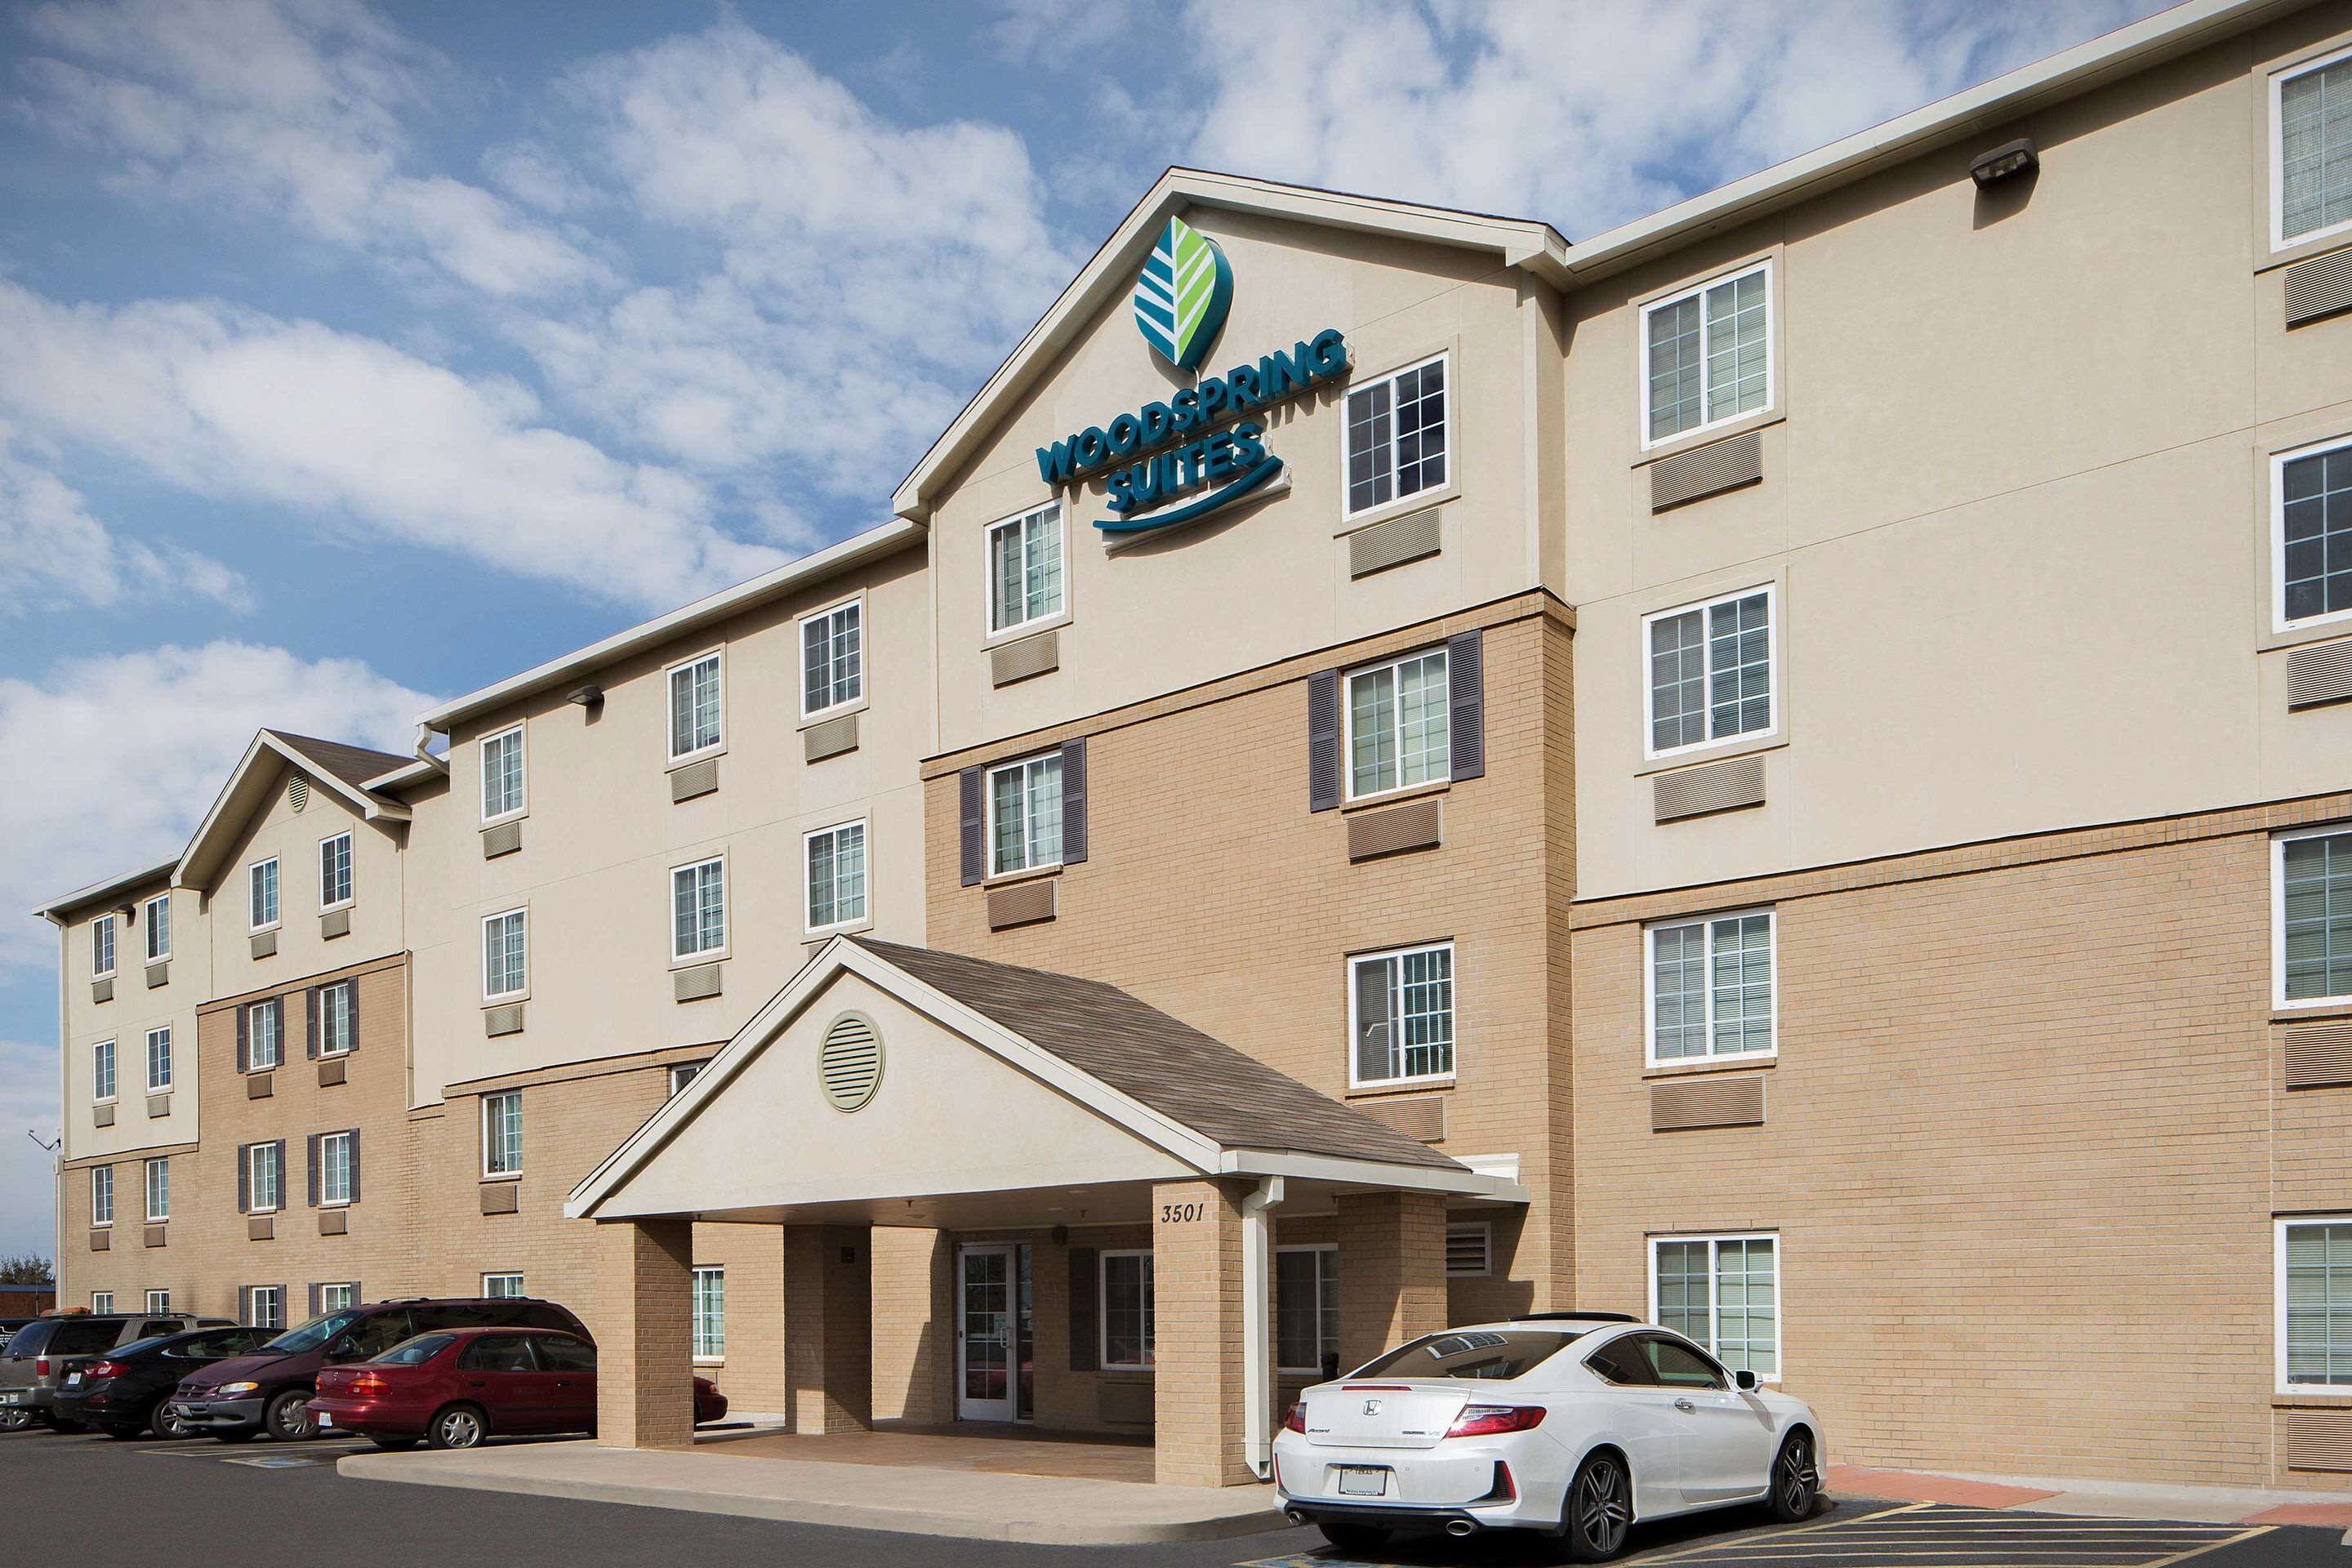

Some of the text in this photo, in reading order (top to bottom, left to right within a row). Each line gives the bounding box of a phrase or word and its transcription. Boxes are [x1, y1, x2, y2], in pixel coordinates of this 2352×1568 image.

[1036, 328, 1348, 485] WOODSPRING
[1107, 421, 1267, 513] SUITES
[1161, 1203, 1204, 1223] 3501
